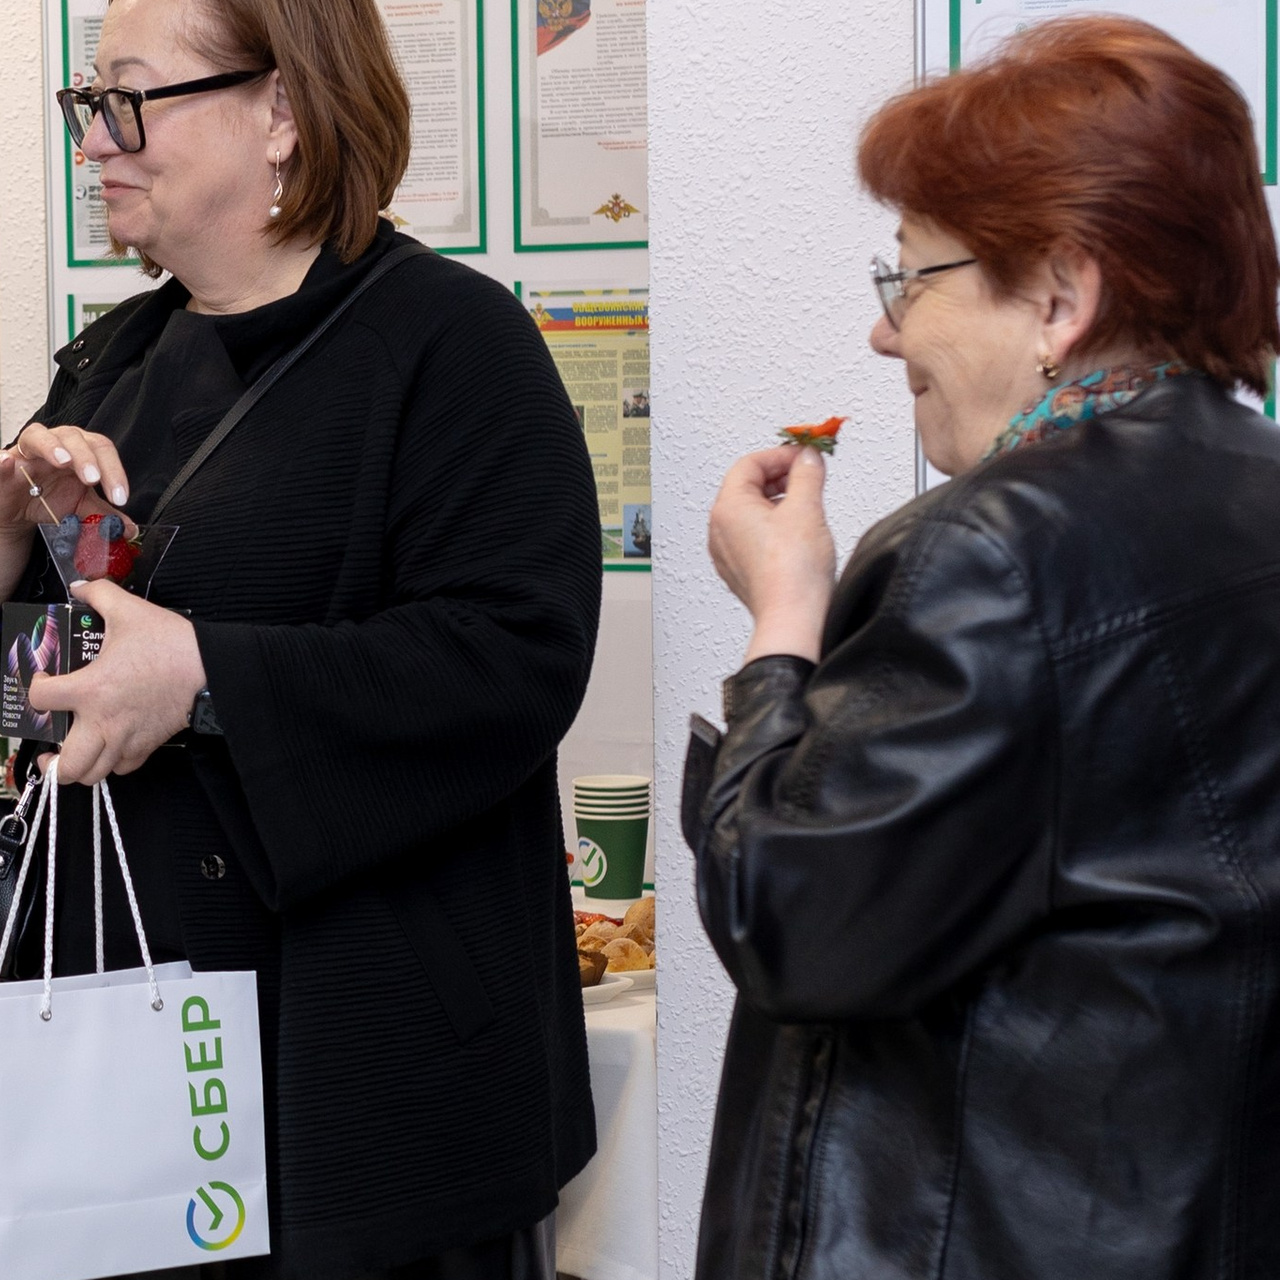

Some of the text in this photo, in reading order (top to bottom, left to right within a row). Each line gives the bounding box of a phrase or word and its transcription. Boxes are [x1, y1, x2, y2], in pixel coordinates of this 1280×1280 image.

[82, 641, 100, 651] Это
[2, 710, 22, 720] Новости
[181, 995, 230, 1161] СБЕР
